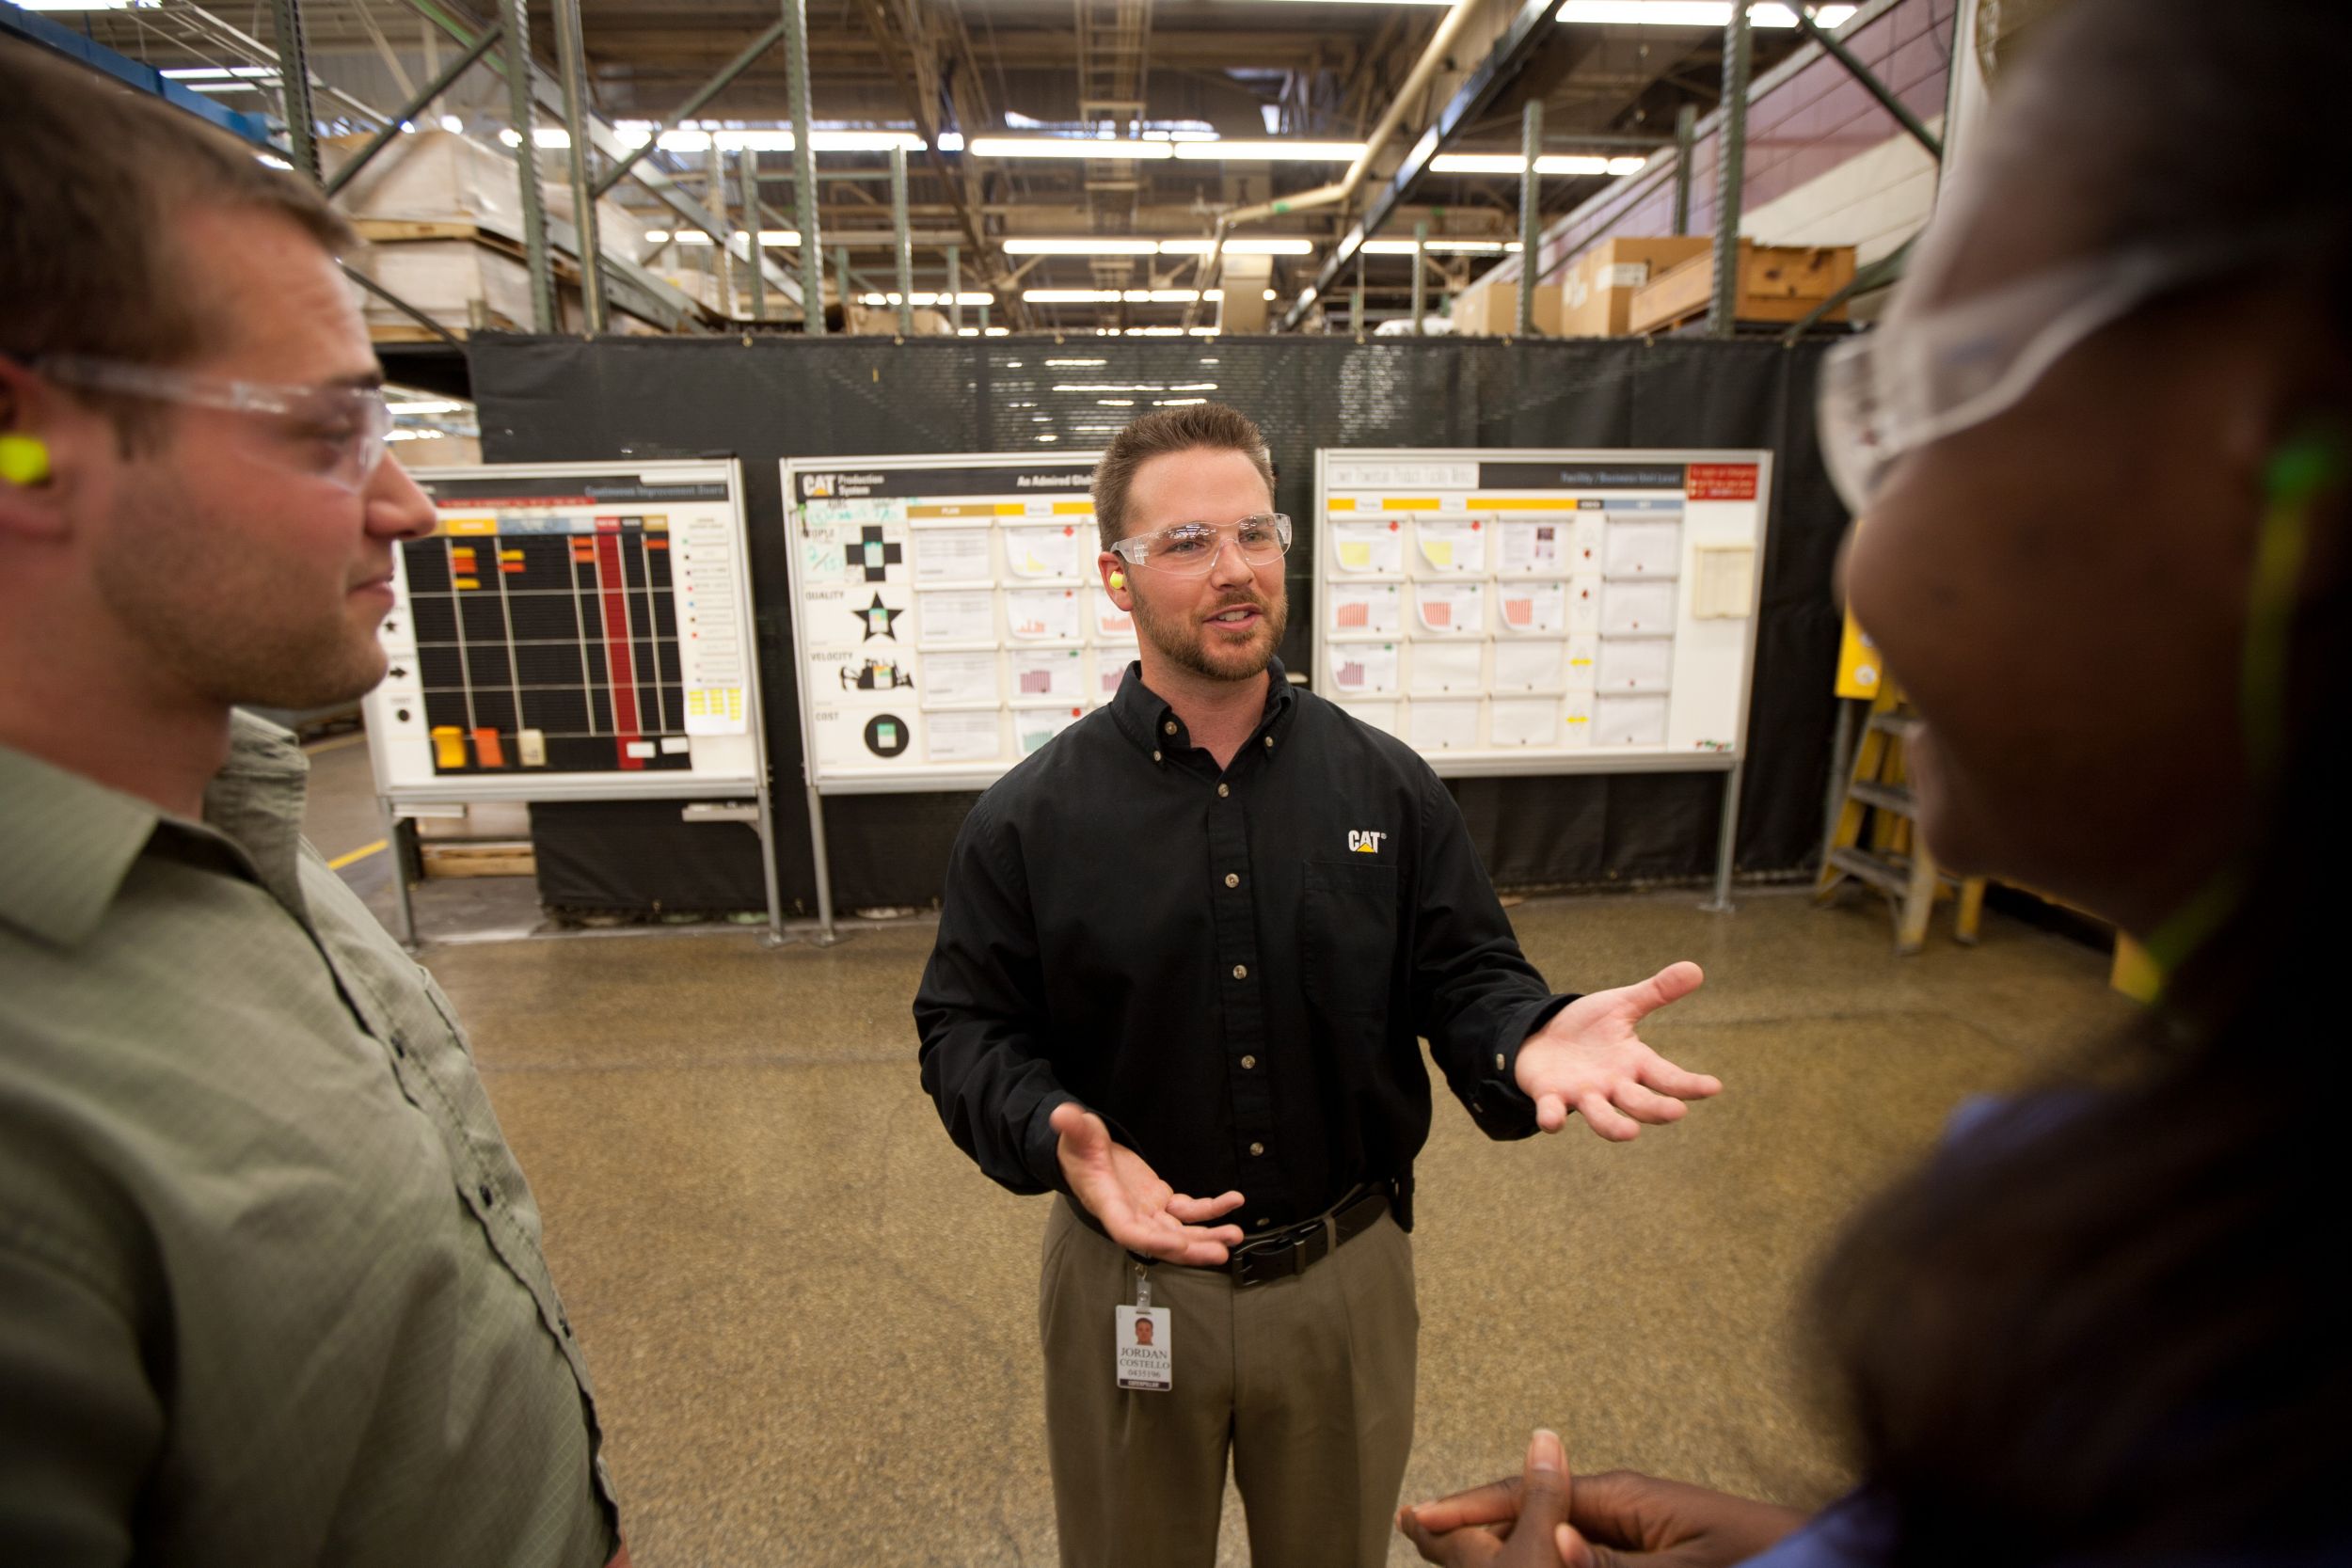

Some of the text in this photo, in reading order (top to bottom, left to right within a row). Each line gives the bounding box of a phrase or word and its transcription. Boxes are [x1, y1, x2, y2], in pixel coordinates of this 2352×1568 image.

[837, 473, 884, 484] Production
[1017, 475, 1031, 487] An
[1032, 474, 1071, 487] Admired
[585, 482, 723, 499] Continuous Improvement Board
[803, 474, 835, 497] CAT
[838, 486, 870, 497] System
[805, 591, 845, 600] QUALITY
[809, 652, 853, 661] VELOCITY
[816, 712, 839, 721] COST
[1120, 1348, 1168, 1359] JORDAN
[1120, 1358, 1170, 1370] COSTELLO
